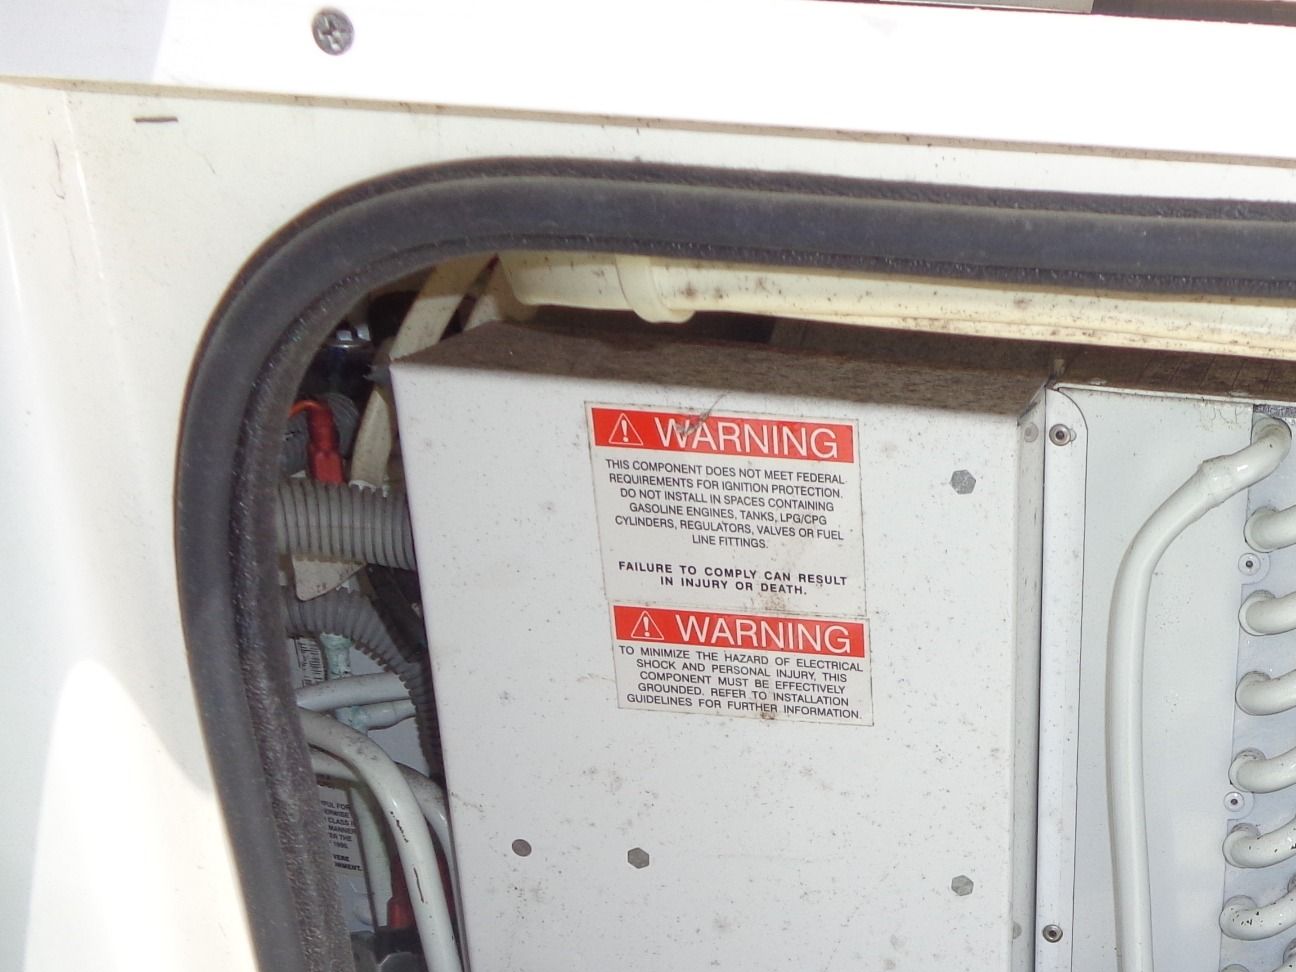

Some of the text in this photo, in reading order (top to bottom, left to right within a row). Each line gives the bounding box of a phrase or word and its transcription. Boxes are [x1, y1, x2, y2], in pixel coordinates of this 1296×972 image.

[654, 417, 838, 458] WARNING
[606, 459, 844, 484] THIS COMPONENT DOES NOT MEET FEDERAL
[610, 474, 842, 498] REQUIREMENTS FOR IGNITION PROTECTION.
[621, 488, 834, 512] DO NOT INSTALL IN SPACES CONTAINING
[630, 503, 827, 525] GASOLINE ENGINES, TANKS, LPG/CPG
[616, 516, 844, 540] CYLINDERS, REGULATORS, VALVES OR FUEL
[692, 535, 768, 548] LINE FITTINGS.
[619, 562, 847, 586] FAILURE TO COMPLY CAN RESULT
[661, 576, 807, 595] IN INJURY OR DEATH.
[676, 614, 850, 654] WARNING
[619, 646, 863, 671] TO MINIMIZE THE HAZARD OF ELECTRICAL
[637, 659, 676, 670] SHOCK
[682, 662, 705, 672] AND
[712, 664, 770, 677] PERSONAL
[823, 672, 847, 682] THIS
[638, 683, 848, 706] GROUNDED. REFER TO INSTALLATION
[640, 671, 845, 694] COMPONENT MUST BE EFFECTIVELY
[627, 694, 862, 719] GUIDELINES FOR FURTHER INFORMATION.
